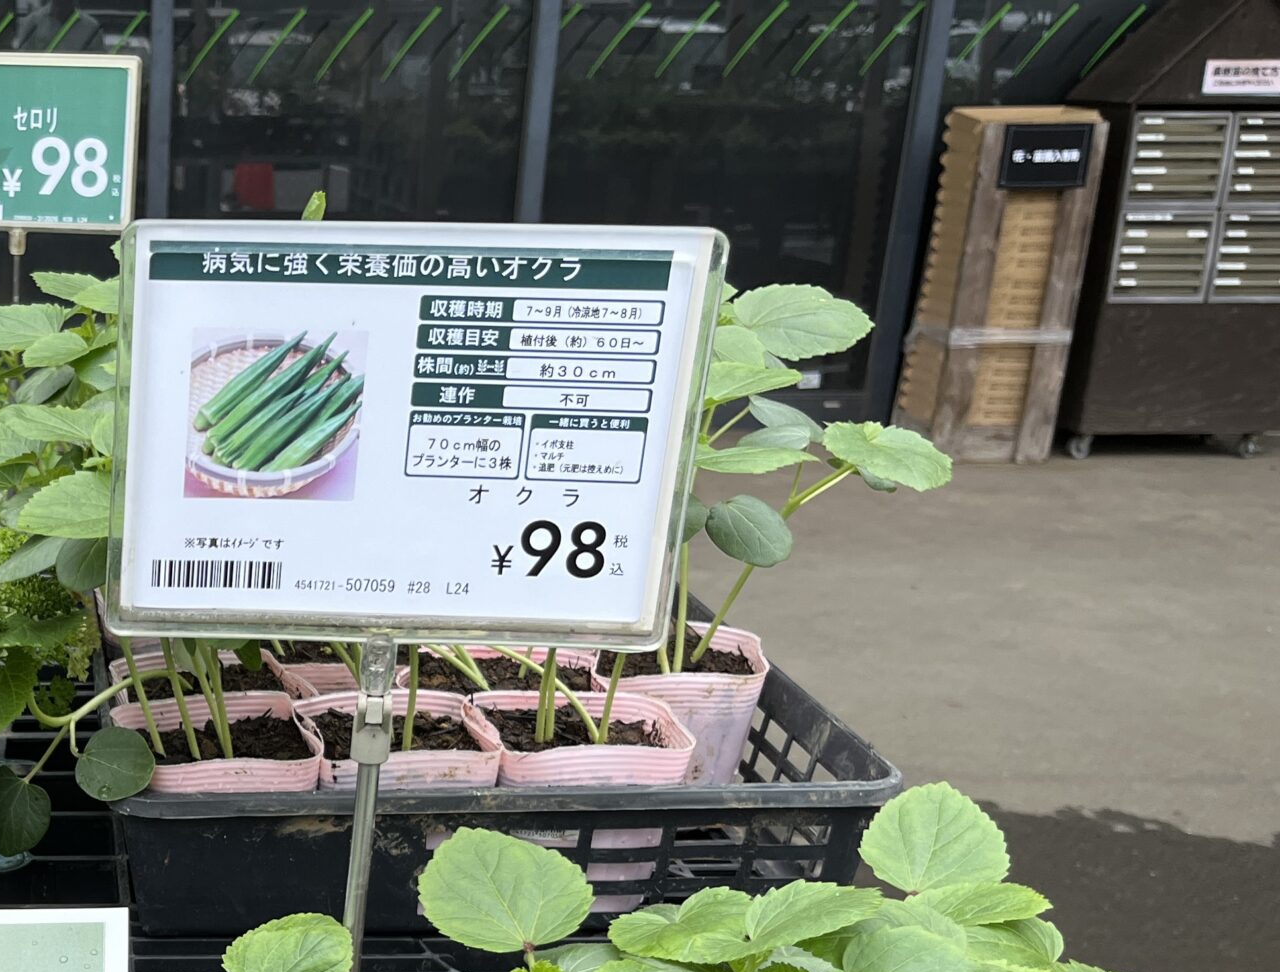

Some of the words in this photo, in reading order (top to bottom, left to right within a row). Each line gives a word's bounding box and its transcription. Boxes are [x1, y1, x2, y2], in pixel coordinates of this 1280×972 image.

[13, 106, 58, 133] セロリ
[202, 250, 584, 281] 病気に強く栄養価の高いオクラ
[429, 299, 504, 318] 収穫時期
[427, 328, 500, 347] 収穫目安
[439, 386, 476, 404] 連作
[560, 393, 589, 408] 不可
[549, 418, 631, 430] 一緒に買うと便利
[469, 484, 580, 508] オクラ
[294, 578, 396, 593] 4541721-507059
[408, 581, 431, 594] #28
[446, 582, 470, 595] L24
